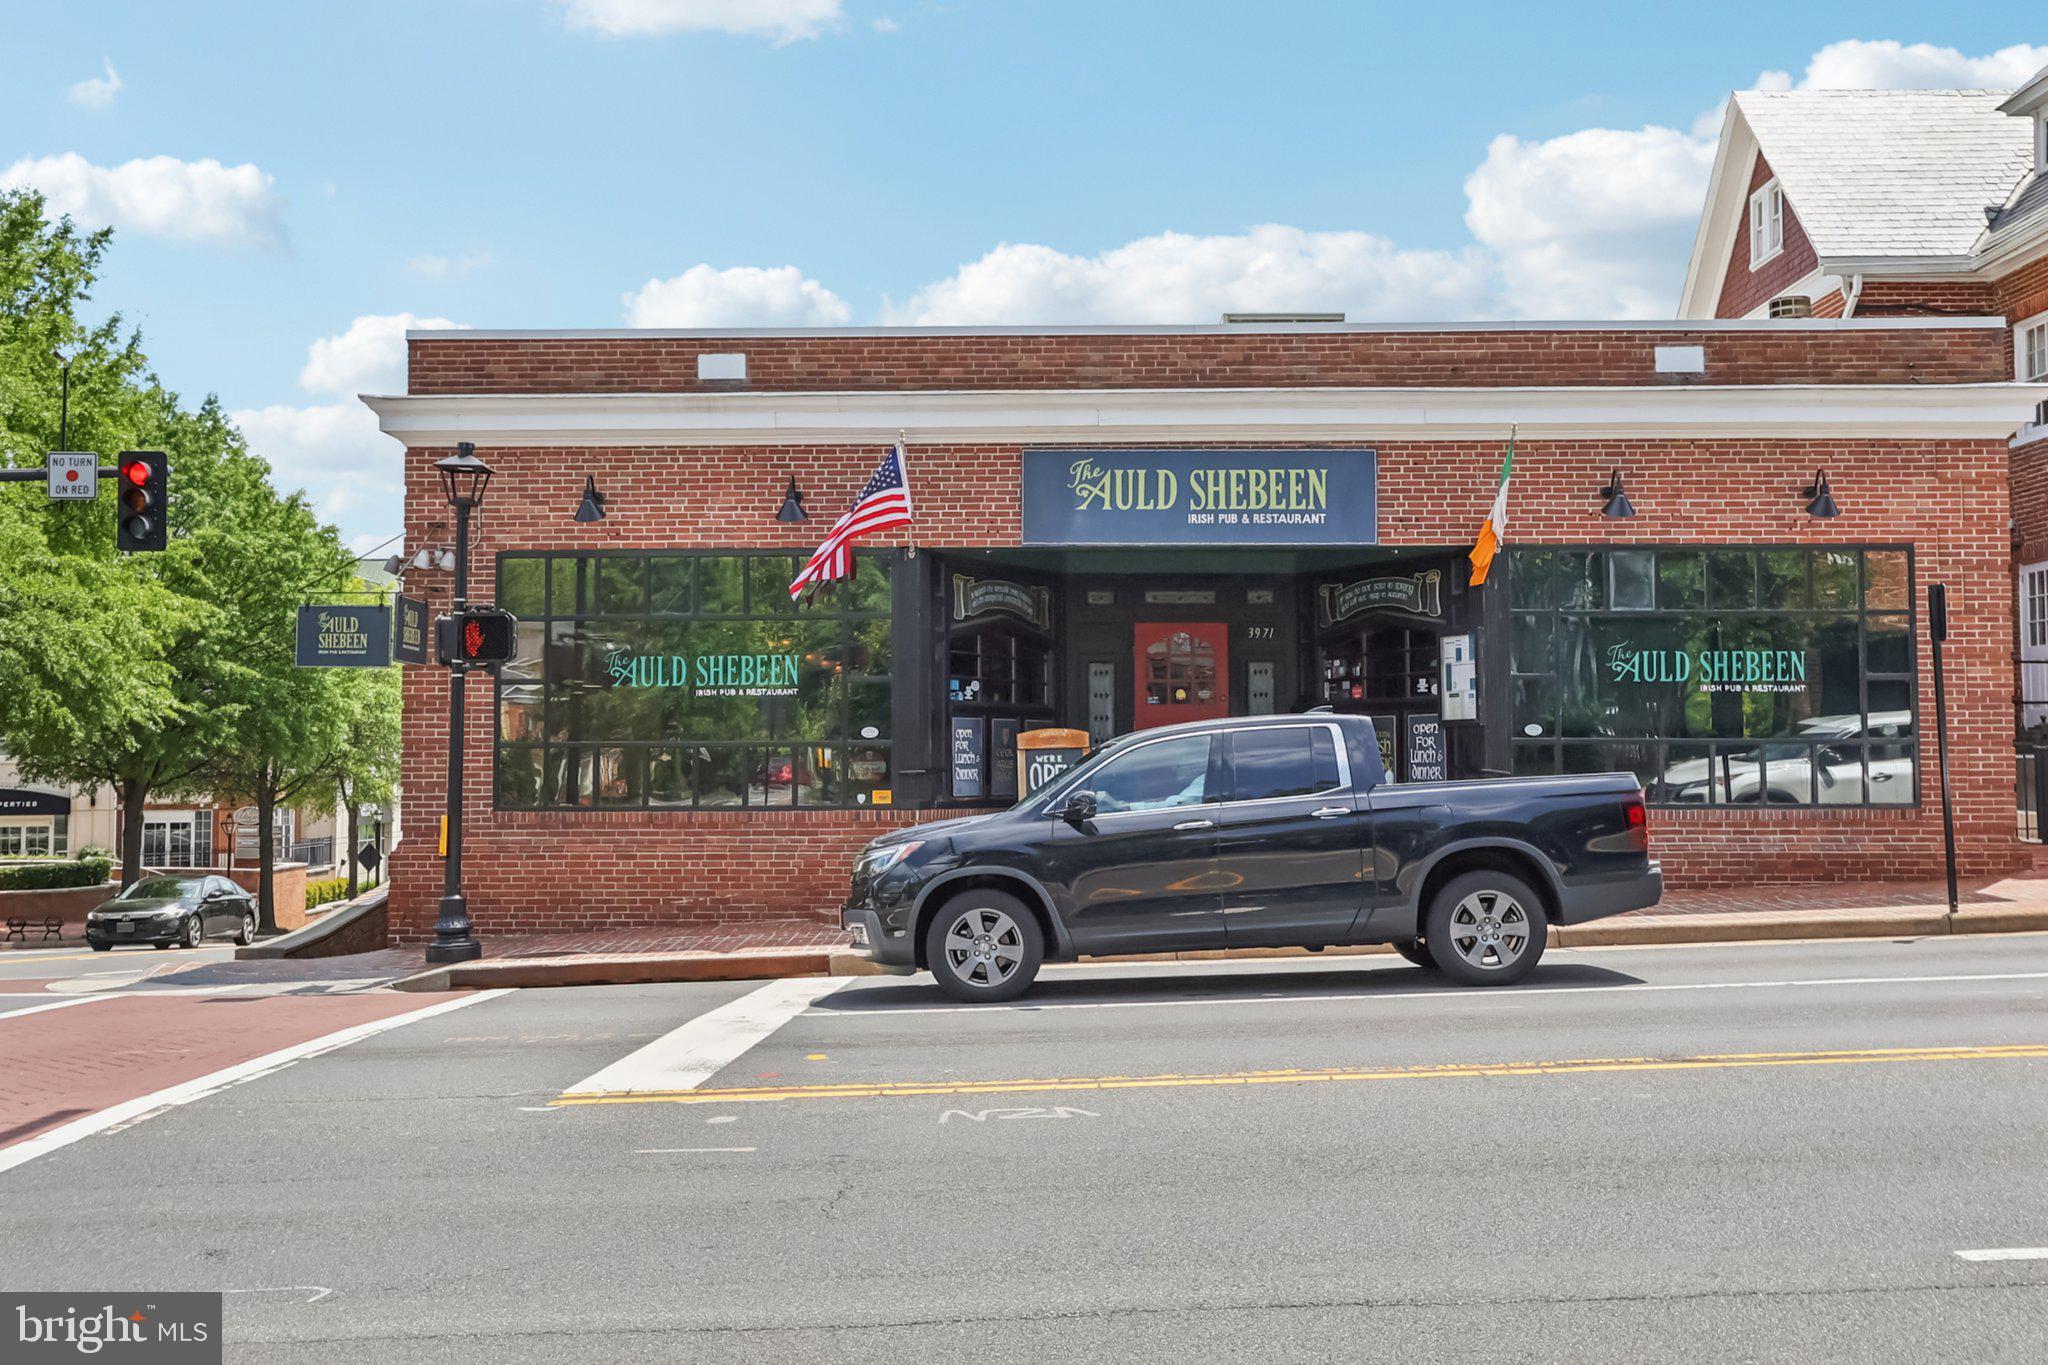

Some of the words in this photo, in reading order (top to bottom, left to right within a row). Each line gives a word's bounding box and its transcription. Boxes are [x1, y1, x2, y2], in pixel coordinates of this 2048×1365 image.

[52, 457, 65, 467] NO
[69, 457, 92, 467] TURN
[1067, 457, 1104, 488] The
[55, 485, 68, 494] ON
[71, 485, 89, 494] RED
[1075, 469, 1178, 511] AULD
[1189, 469, 1329, 511] SHEBEEN
[1187, 513, 1214, 524] IRISH
[1218, 513, 1238, 524] PUB
[1241, 513, 1250, 524] &
[1253, 513, 1326, 524] RESTAURANT
[318, 616, 359, 633] AULD
[1248, 627, 1274, 640] 3971
[318, 633, 368, 649] SHEBEEN
[603, 647, 630, 674] The
[1607, 640, 1633, 666] The
[610, 655, 687, 687] AULD
[696, 655, 799, 687] SHEBEEN
[1612, 650, 1690, 683] AULD
[1700, 650, 1806, 683] SHEBEEN
[696, 689, 716, 697] IRISH
[719, 689, 736, 697] PUB
[746, 688, 799, 697] RESTAURANT
[1700, 684, 1722, 693] IRISH
[1725, 684, 1742, 693] PUB
[1752, 684, 1806, 693] RESTAURANT
[955, 741, 970, 752] FOR
[1415, 736, 1436, 749] FOR
[1029, 762, 1068, 791] OP
